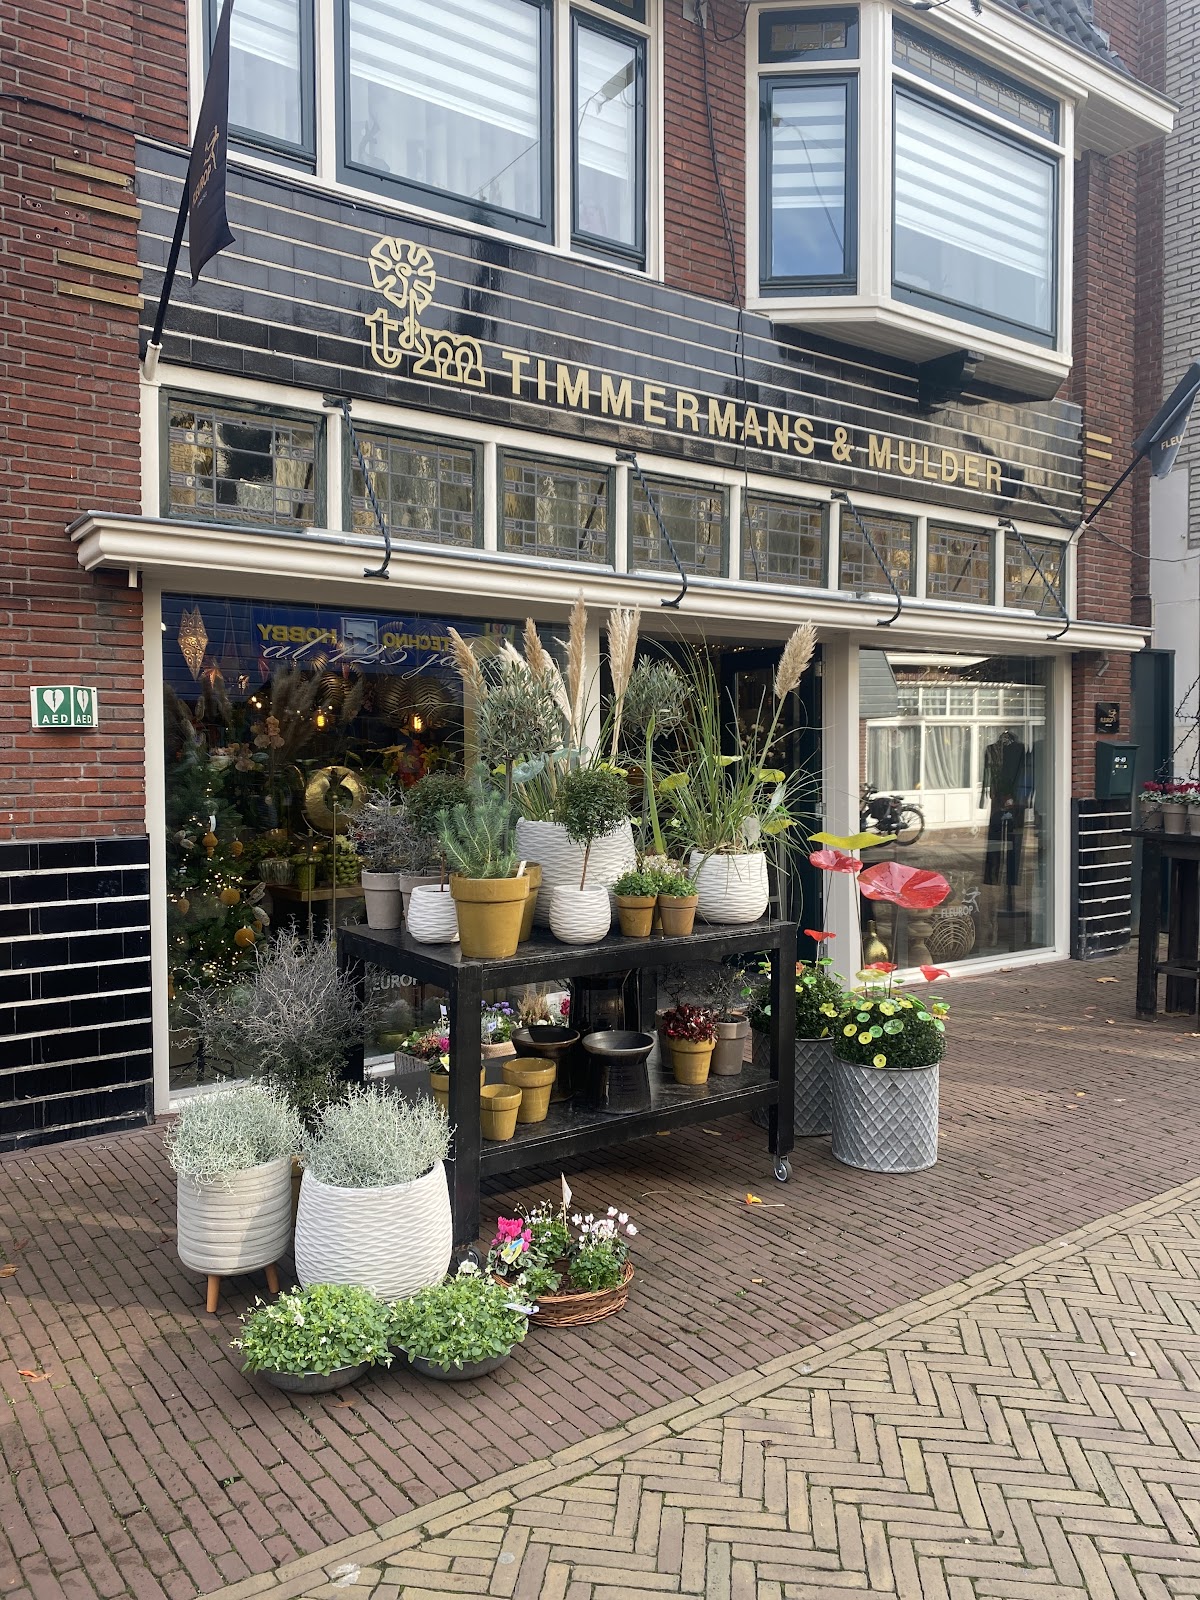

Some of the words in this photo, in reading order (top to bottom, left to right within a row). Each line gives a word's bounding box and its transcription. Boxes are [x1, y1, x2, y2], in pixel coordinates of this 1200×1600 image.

[501, 350, 815, 455] TIMMERMANS
[831, 426, 852, 462] &
[868, 434, 1003, 492] MULDER
[42, 714, 68, 724] AED
[76, 714, 92, 724] AED
[941, 905, 974, 919] FLEUROP
